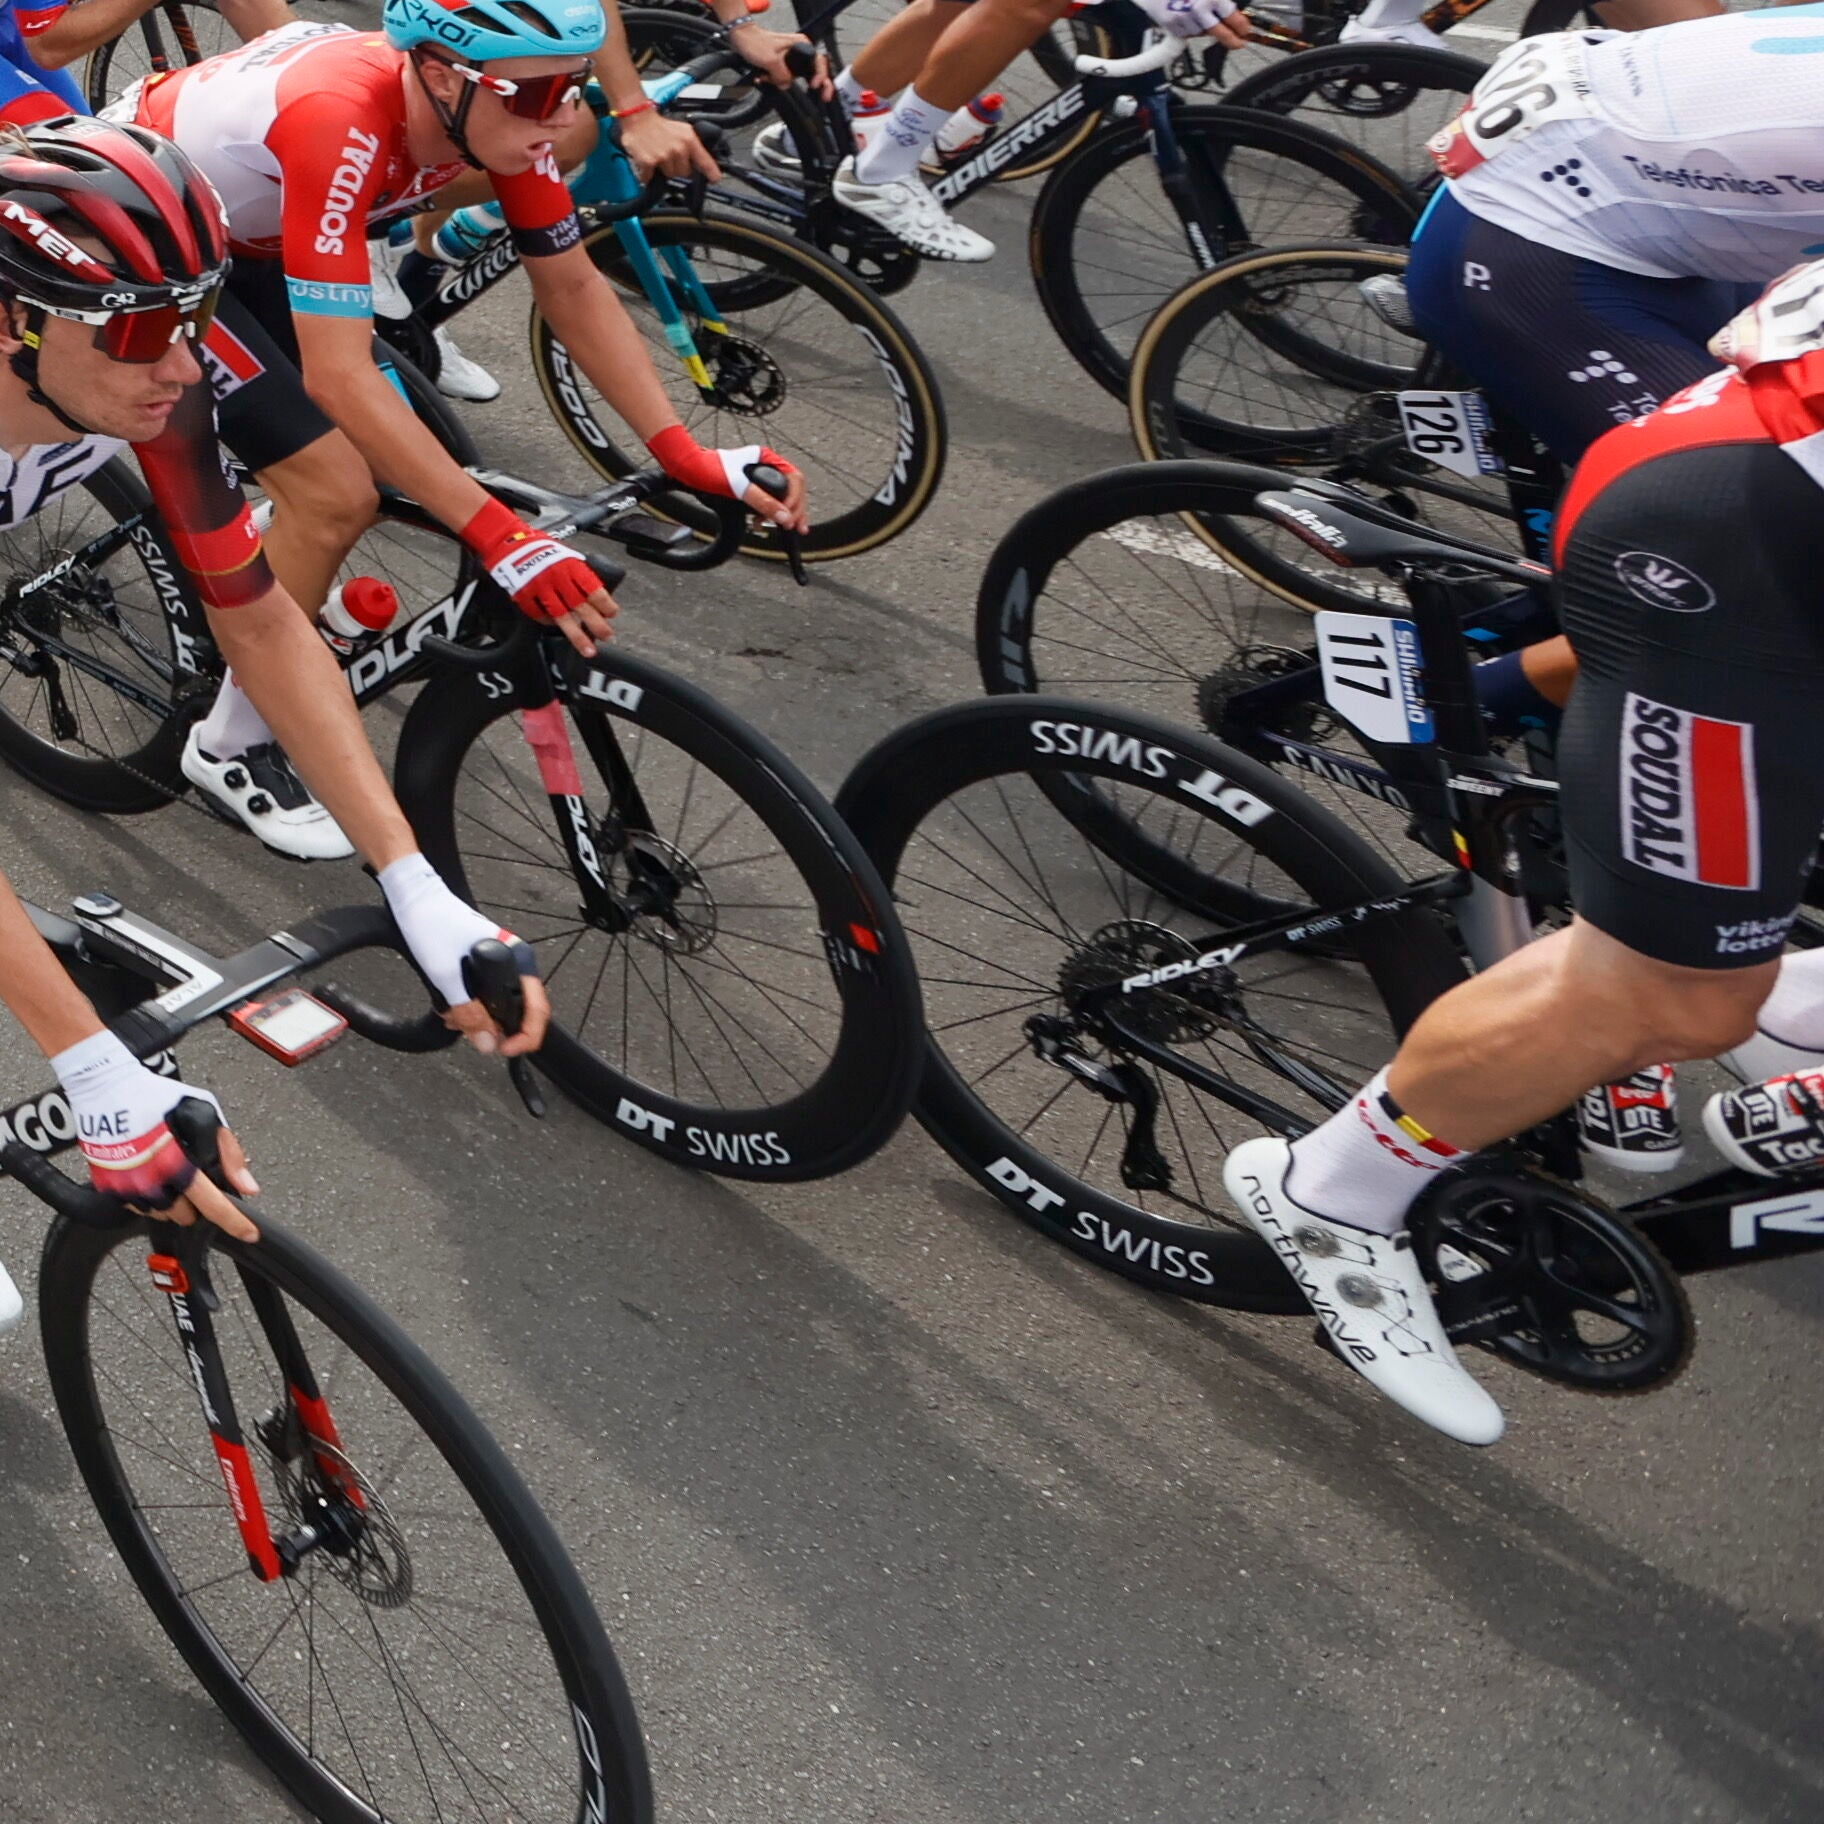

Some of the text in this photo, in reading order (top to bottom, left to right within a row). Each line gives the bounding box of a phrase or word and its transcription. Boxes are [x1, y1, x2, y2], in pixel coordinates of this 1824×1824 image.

[932, 81, 1086, 203] APIERRE
[315, 125, 380, 256] SOUDAL
[1621, 152, 1824, 196] Telefónica Te
[4, 203, 97, 266] MET
[101, 292, 137, 308] G42
[853, 323, 917, 507] CORIMA
[1402, 395, 1463, 457] 126
[19, 556, 77, 599] RIDLEY
[126, 525, 190, 619] SWISS
[173, 628, 201, 672] DT
[1326, 630, 1393, 701] 117
[579, 669, 646, 713] DT
[1032, 719, 1178, 779] SWISS
[1179, 769, 1276, 828] DT
[1619, 696, 1688, 872] SOUDAL
[1122, 943, 1248, 993] RIDLEY
[77, 1109, 131, 1139] UAE
[615, 1097, 792, 1168] DT SWISS
[1757, 1140, 1824, 1165] Tac
[984, 1155, 1216, 1287] DT SWISS
[1239, 1173, 1379, 1365] northwave
[170, 1290, 196, 1333] UAE
